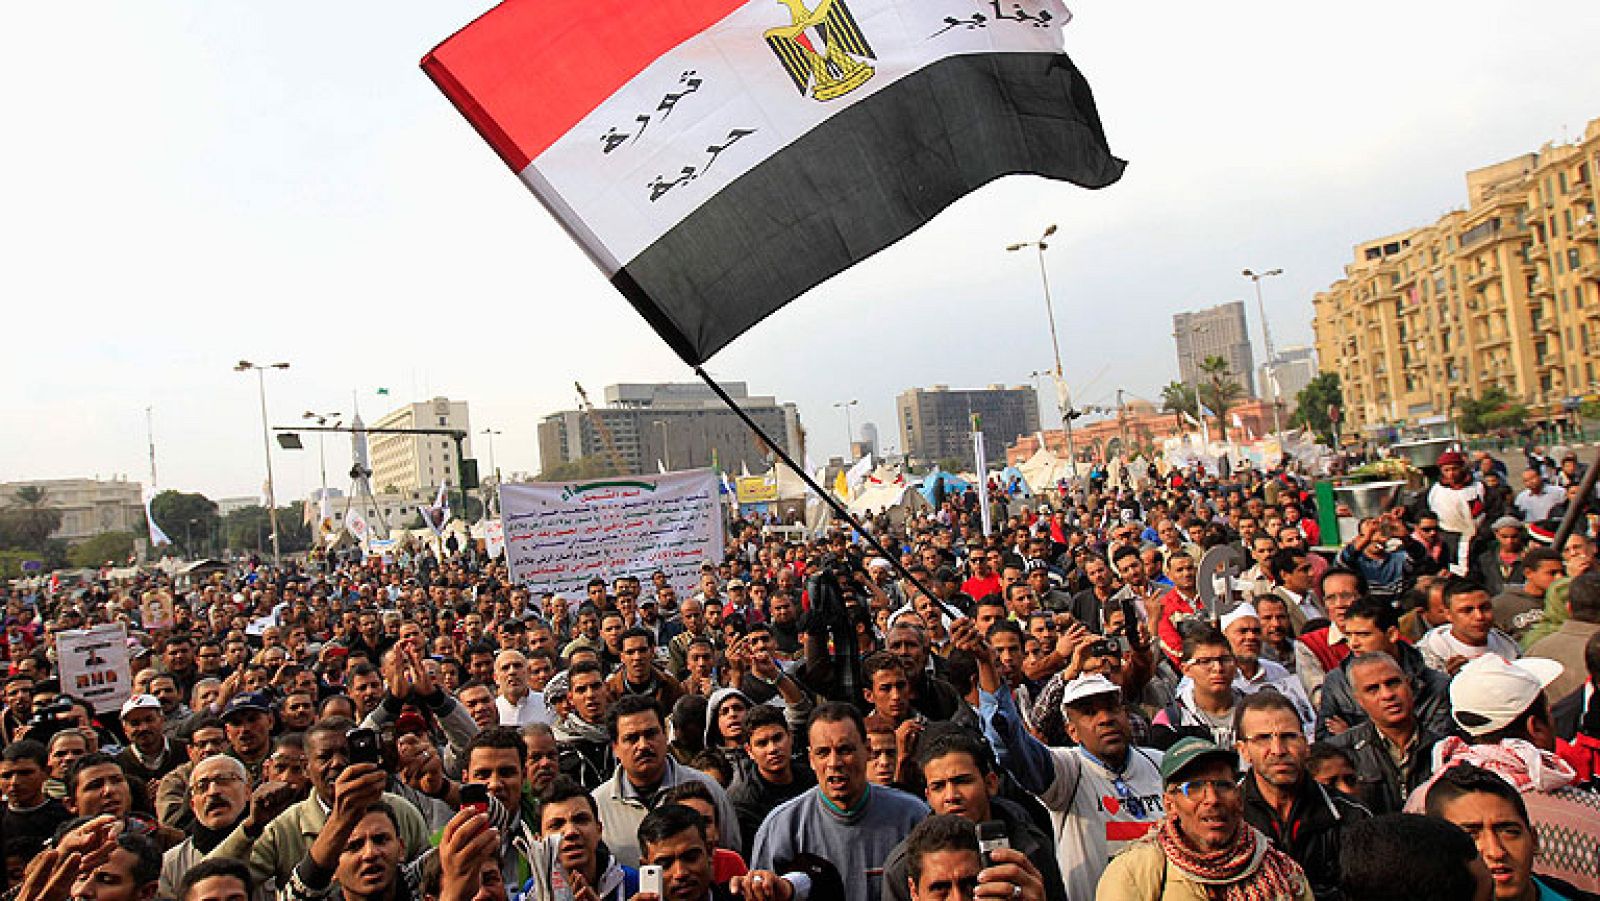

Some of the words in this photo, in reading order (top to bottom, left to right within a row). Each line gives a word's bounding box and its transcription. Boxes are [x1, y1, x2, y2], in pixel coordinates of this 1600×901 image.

[600, 70, 703, 154] ثورة
[647, 127, 759, 203] حرية
[1118, 794, 1164, 812] EPT
